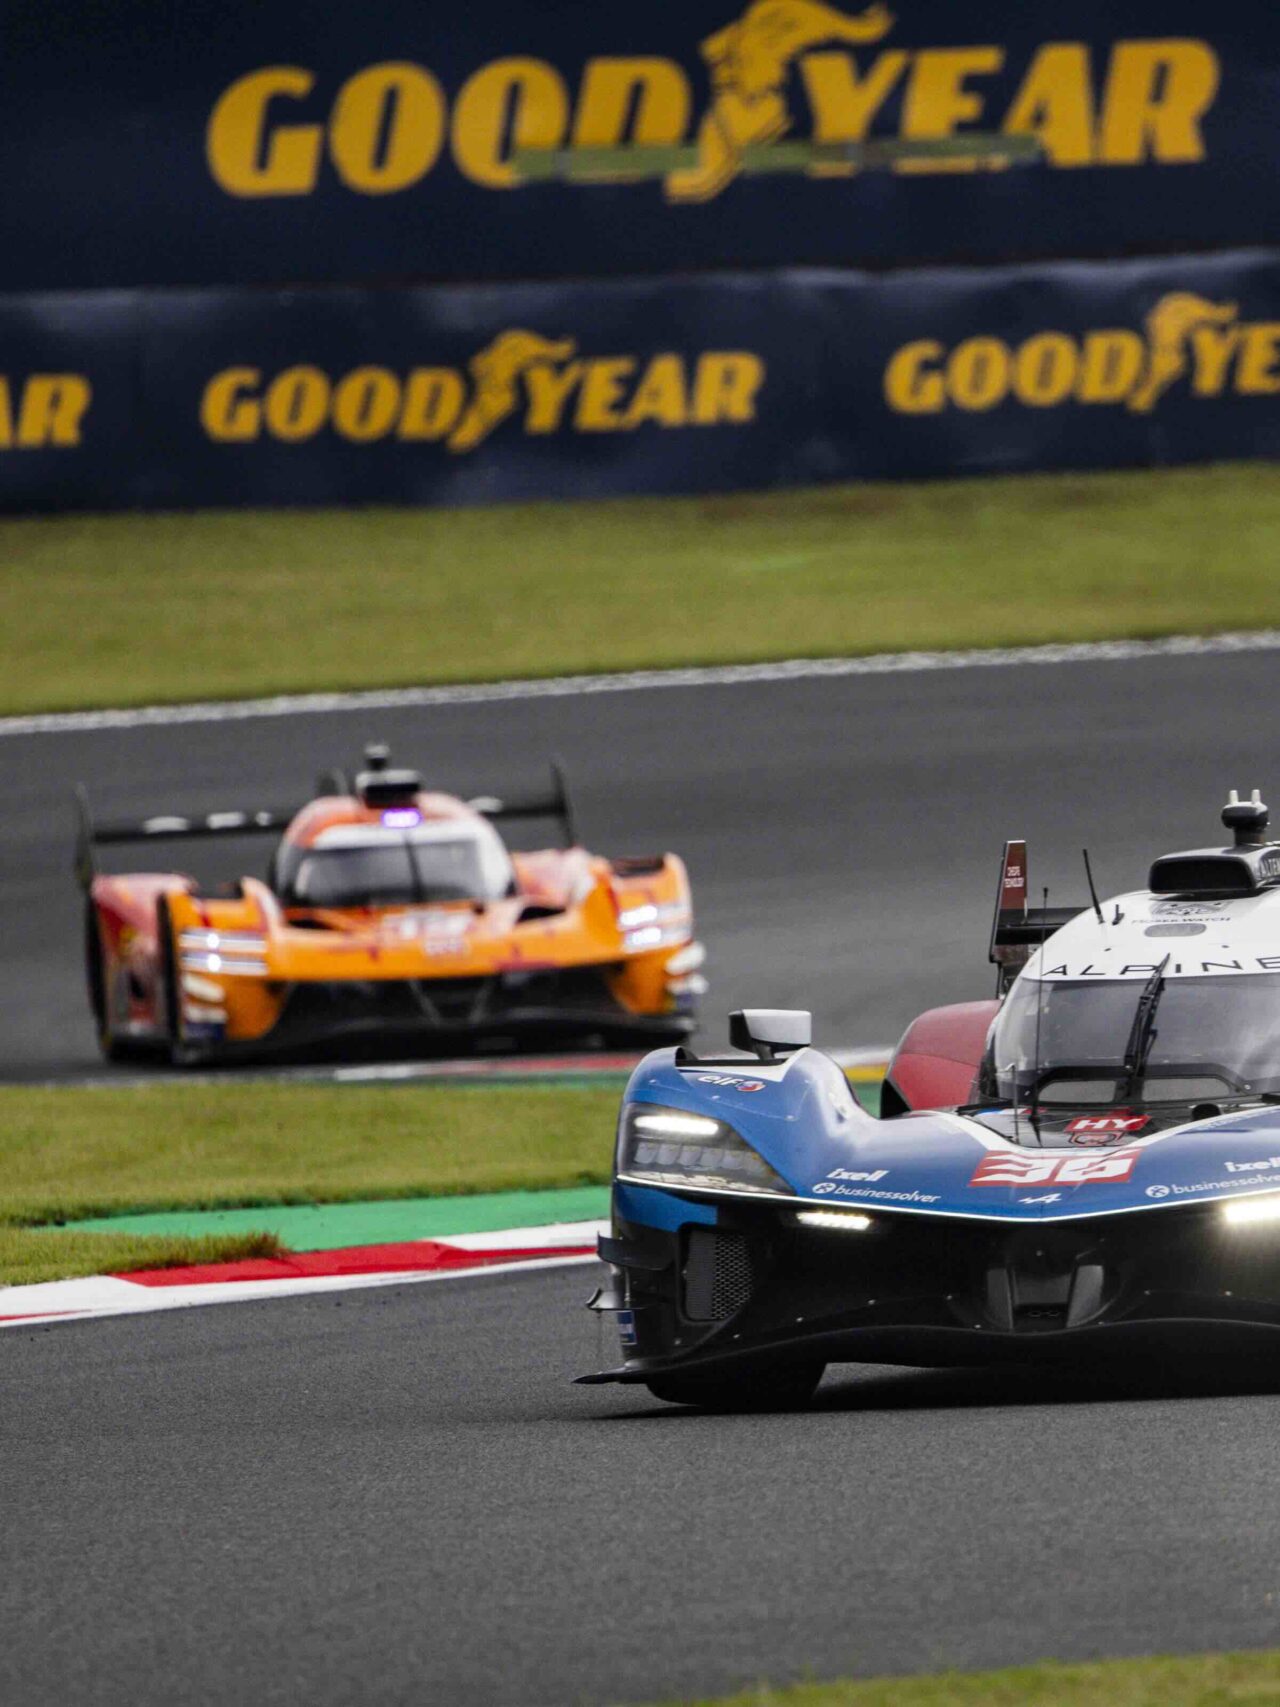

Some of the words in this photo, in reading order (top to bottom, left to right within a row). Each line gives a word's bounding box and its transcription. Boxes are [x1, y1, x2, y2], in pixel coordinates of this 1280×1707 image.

[207, 38, 1219, 196] GOODYEAR
[203, 352, 765, 443] GOODYEAR
[697, 1073, 742, 1086] elf
[1073, 1118, 1143, 1130] HY
[826, 1168, 890, 1182] ixell
[973, 1149, 1138, 1183] 36
[834, 1185, 941, 1203] businessolver
